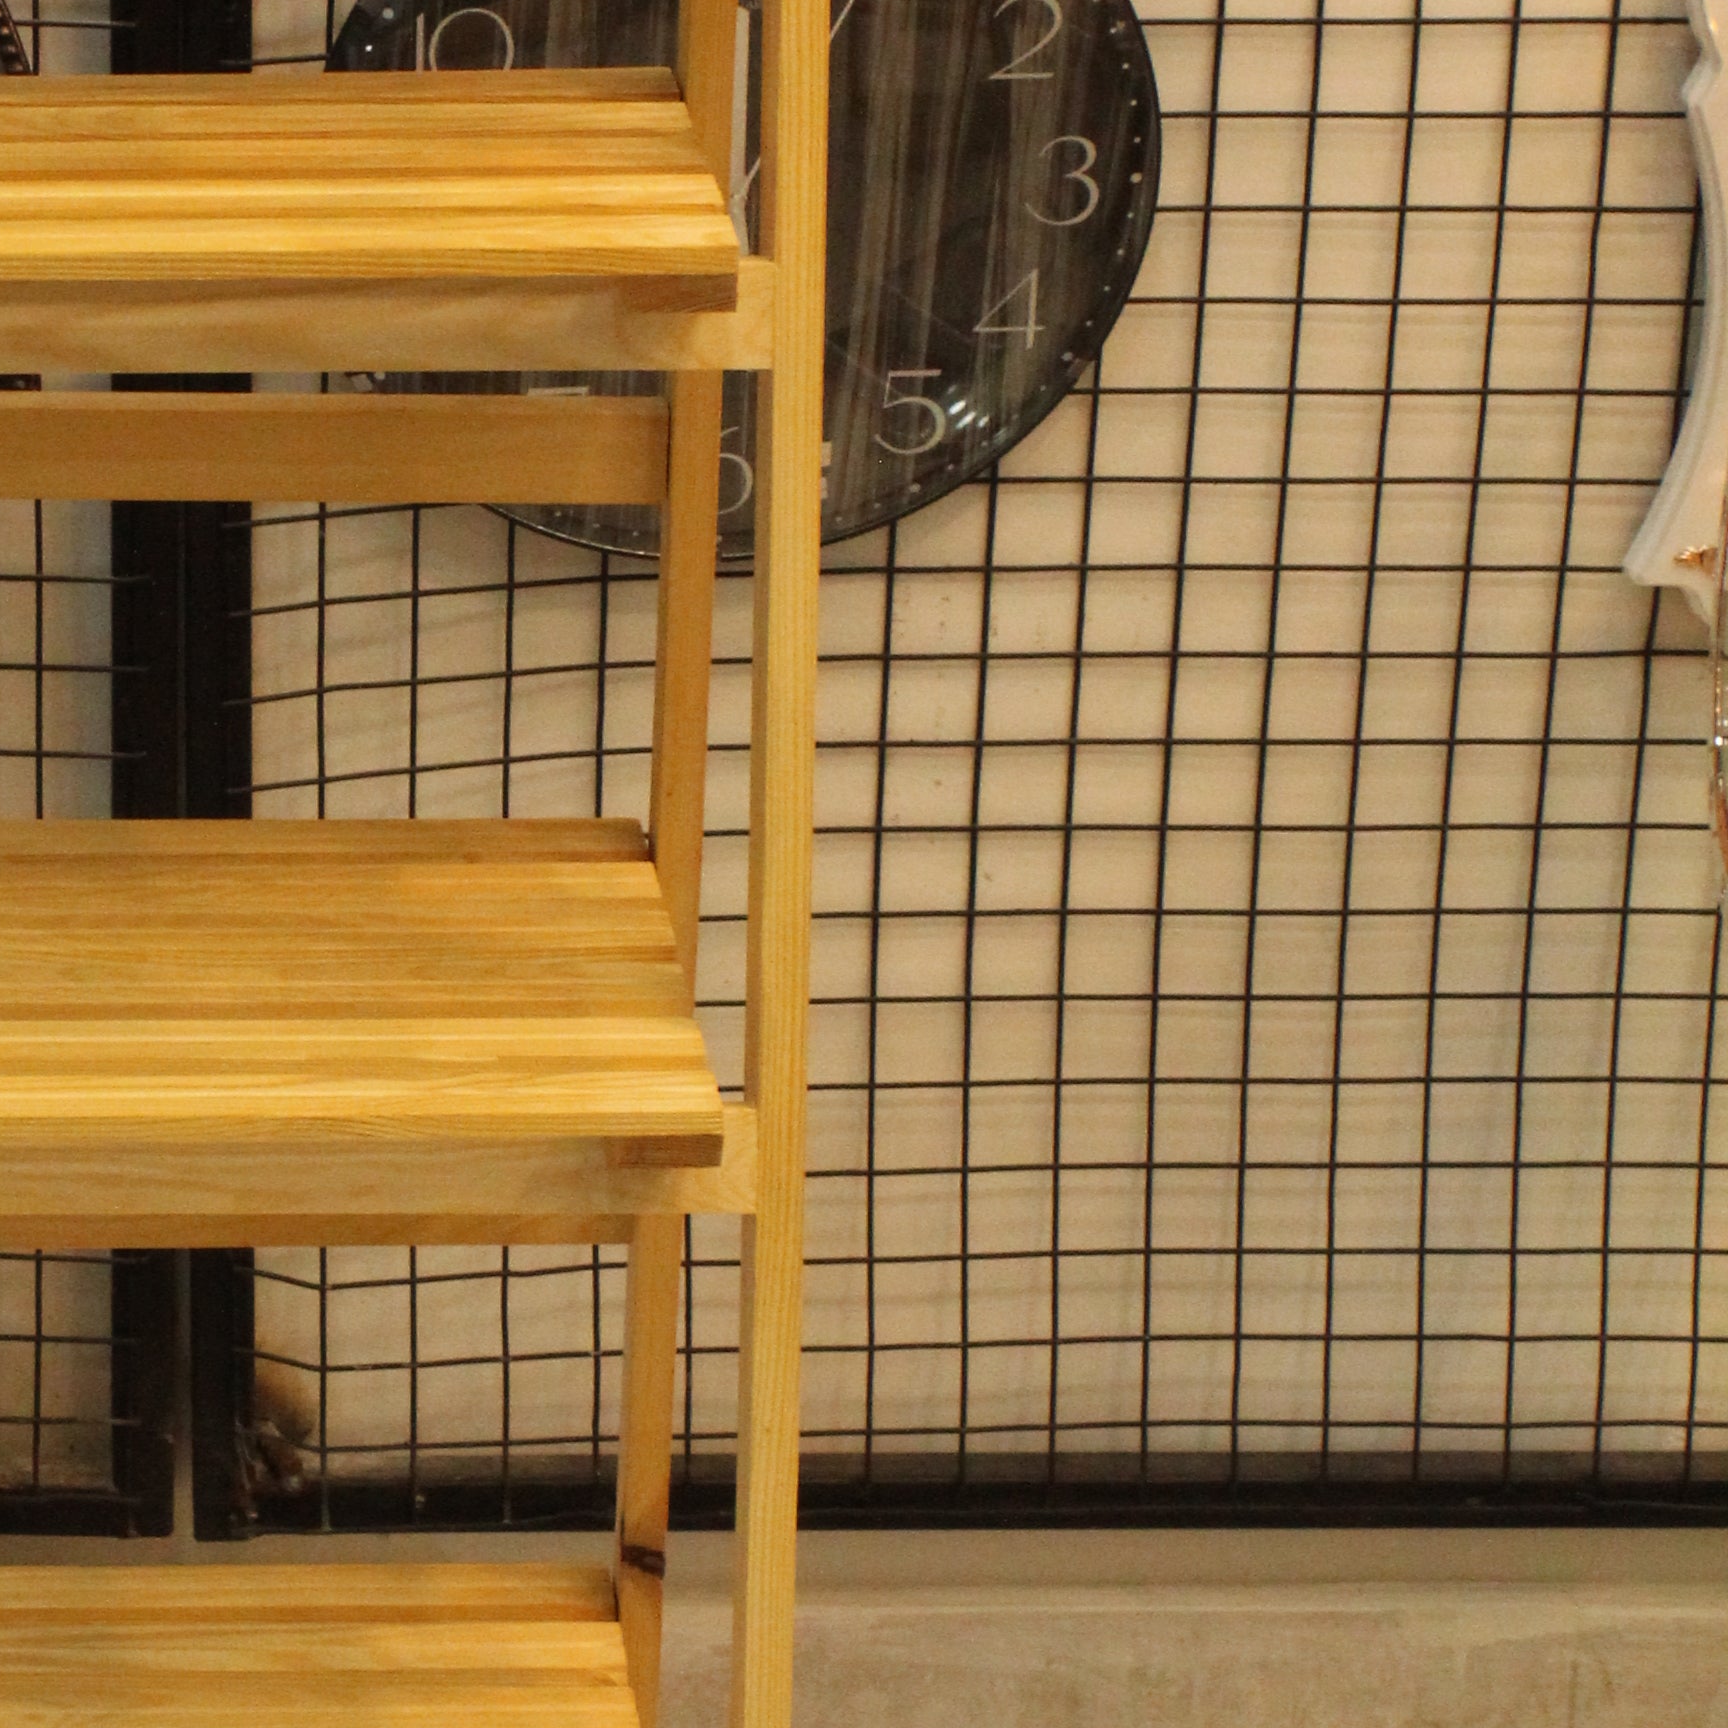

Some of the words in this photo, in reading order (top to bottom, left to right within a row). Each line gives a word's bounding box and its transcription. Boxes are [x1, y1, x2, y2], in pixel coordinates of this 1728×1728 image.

[1025, 135, 1100, 227] 3
[972, 268, 1046, 349] 4
[874, 369, 947, 455] 5
